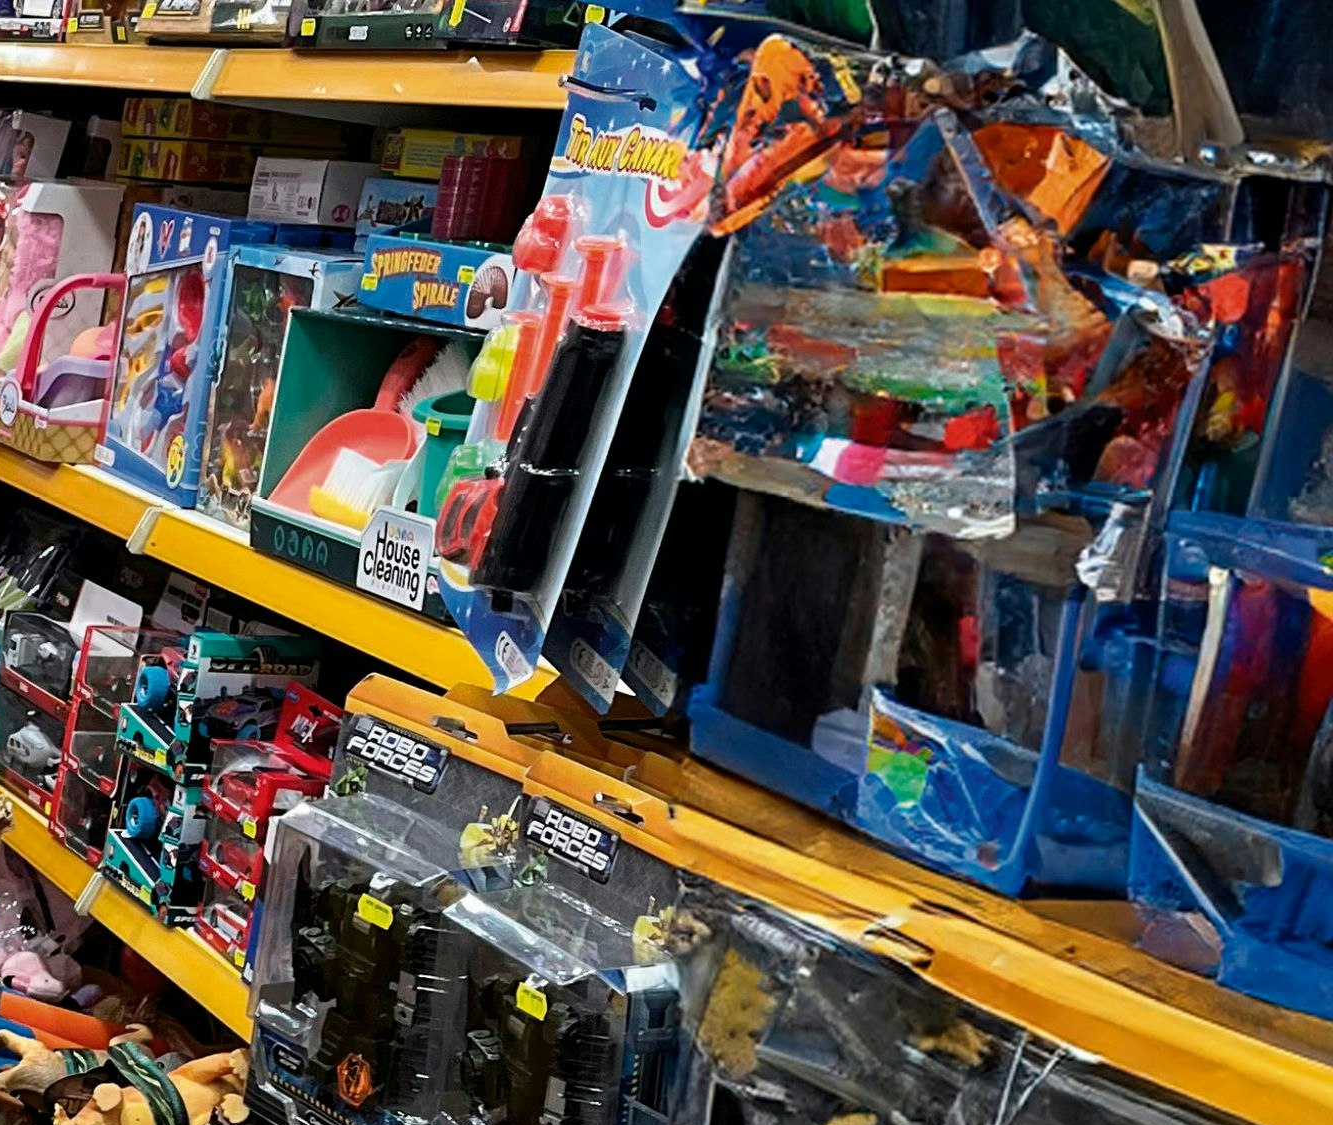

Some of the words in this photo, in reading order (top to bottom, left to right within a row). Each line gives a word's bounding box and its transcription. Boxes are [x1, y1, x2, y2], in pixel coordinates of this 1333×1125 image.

[589, 134, 623, 172] AUX
[618, 126, 681, 181] CANAR
[371, 248, 442, 279] SPRINGFEDER
[412, 279, 460, 312] SPIRALE
[377, 520, 421, 570] House
[363, 546, 421, 602] Cleaning
[346, 735, 437, 783] FORCES
[367, 725, 430, 761] ROBO
[190, 773, 206, 781] SP
[526, 820, 610, 871] FORCES
[545, 809, 602, 847] ROBO
